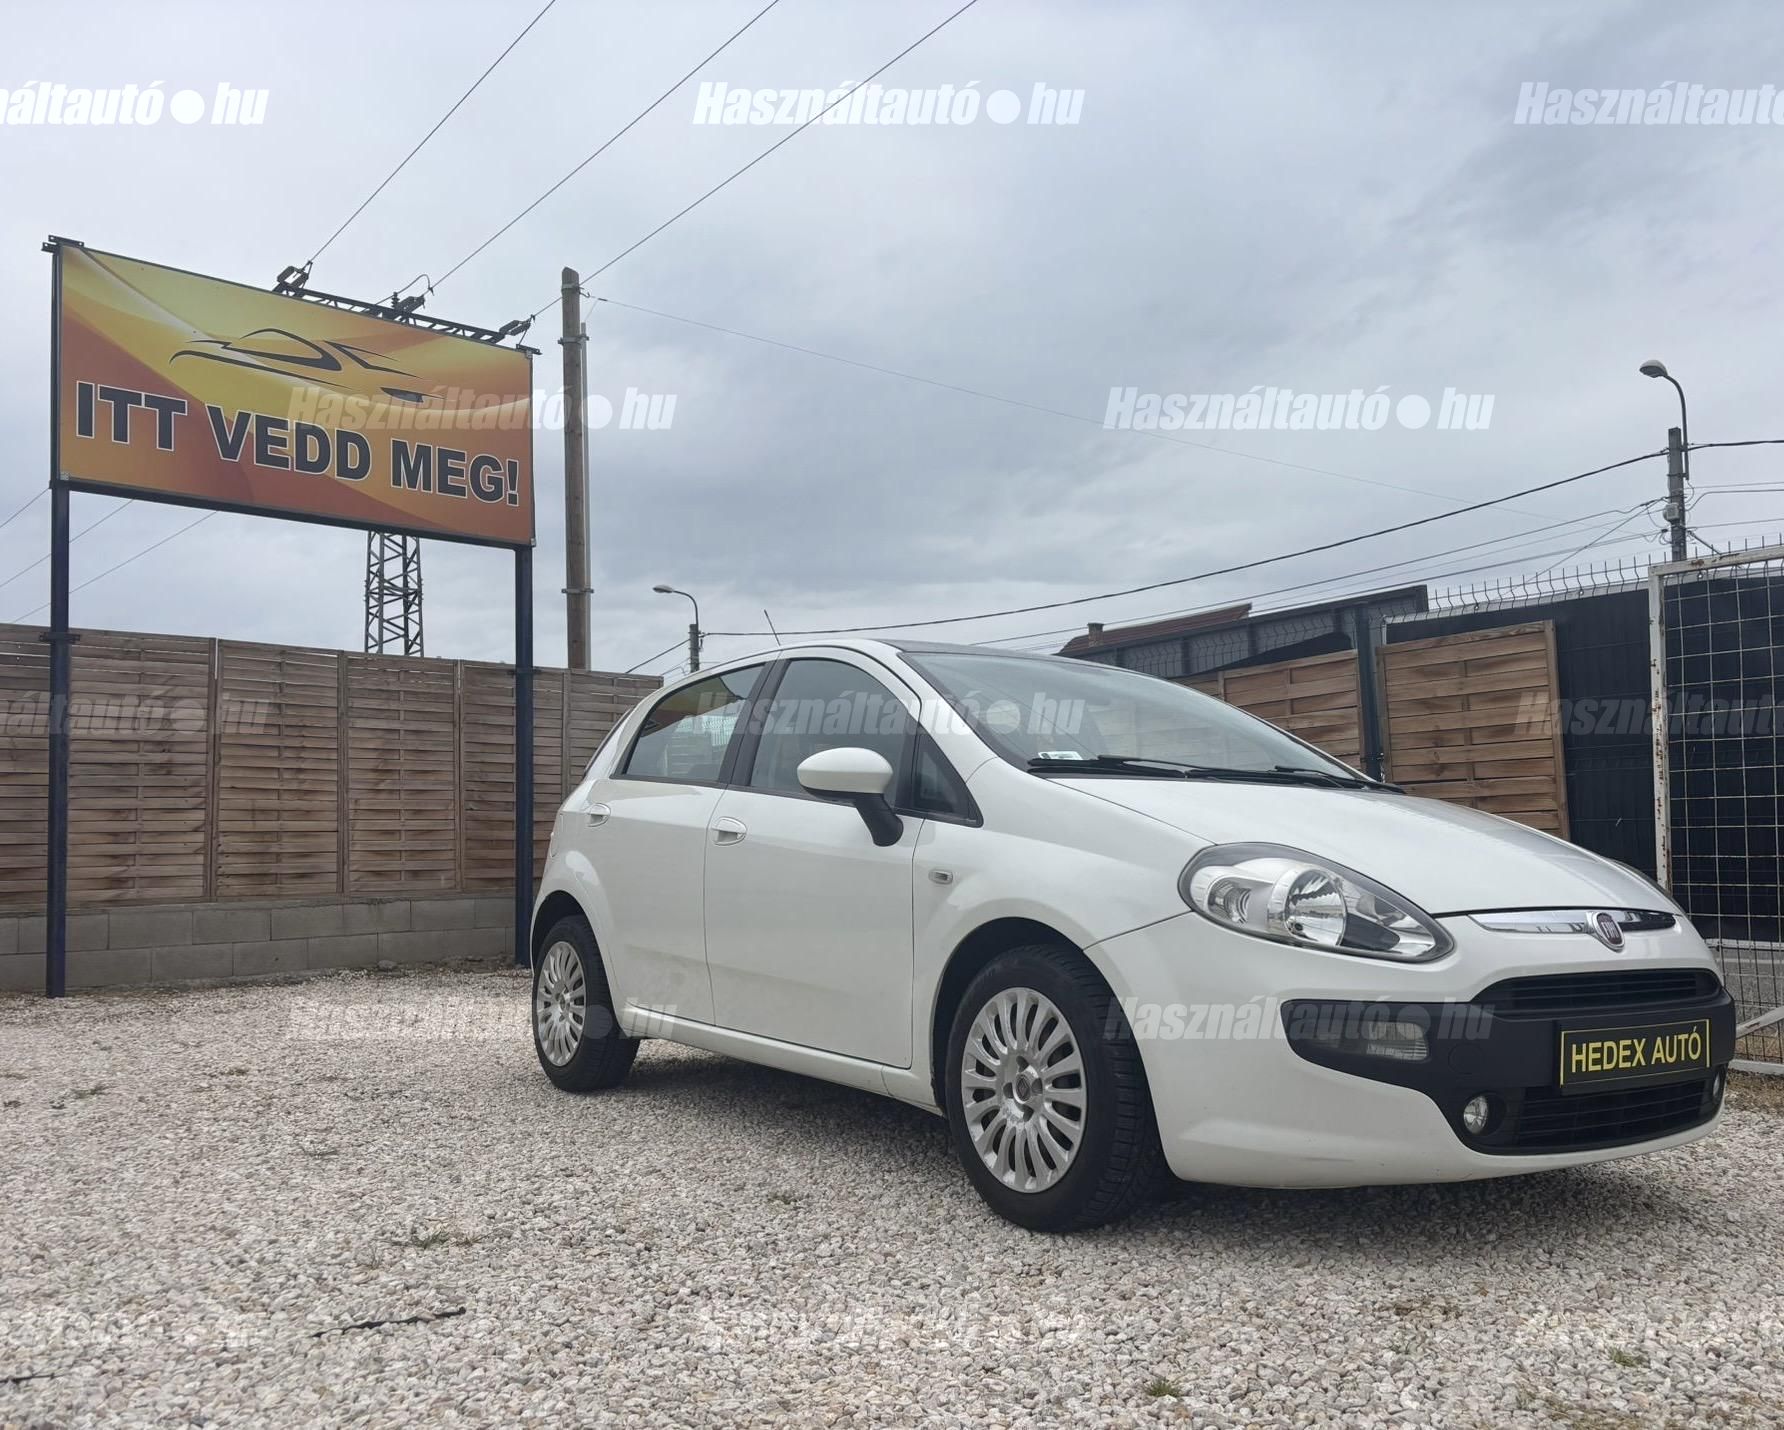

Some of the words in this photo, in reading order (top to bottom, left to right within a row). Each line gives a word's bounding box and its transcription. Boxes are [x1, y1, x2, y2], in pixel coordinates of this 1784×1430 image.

[76, 380, 187, 451] ITT
[205, 403, 371, 481] VEDD
[390, 438, 519, 507] MEG!
[1571, 1038, 1646, 1073] HEDEX
[1651, 1026, 1701, 1065] AUTÓ
